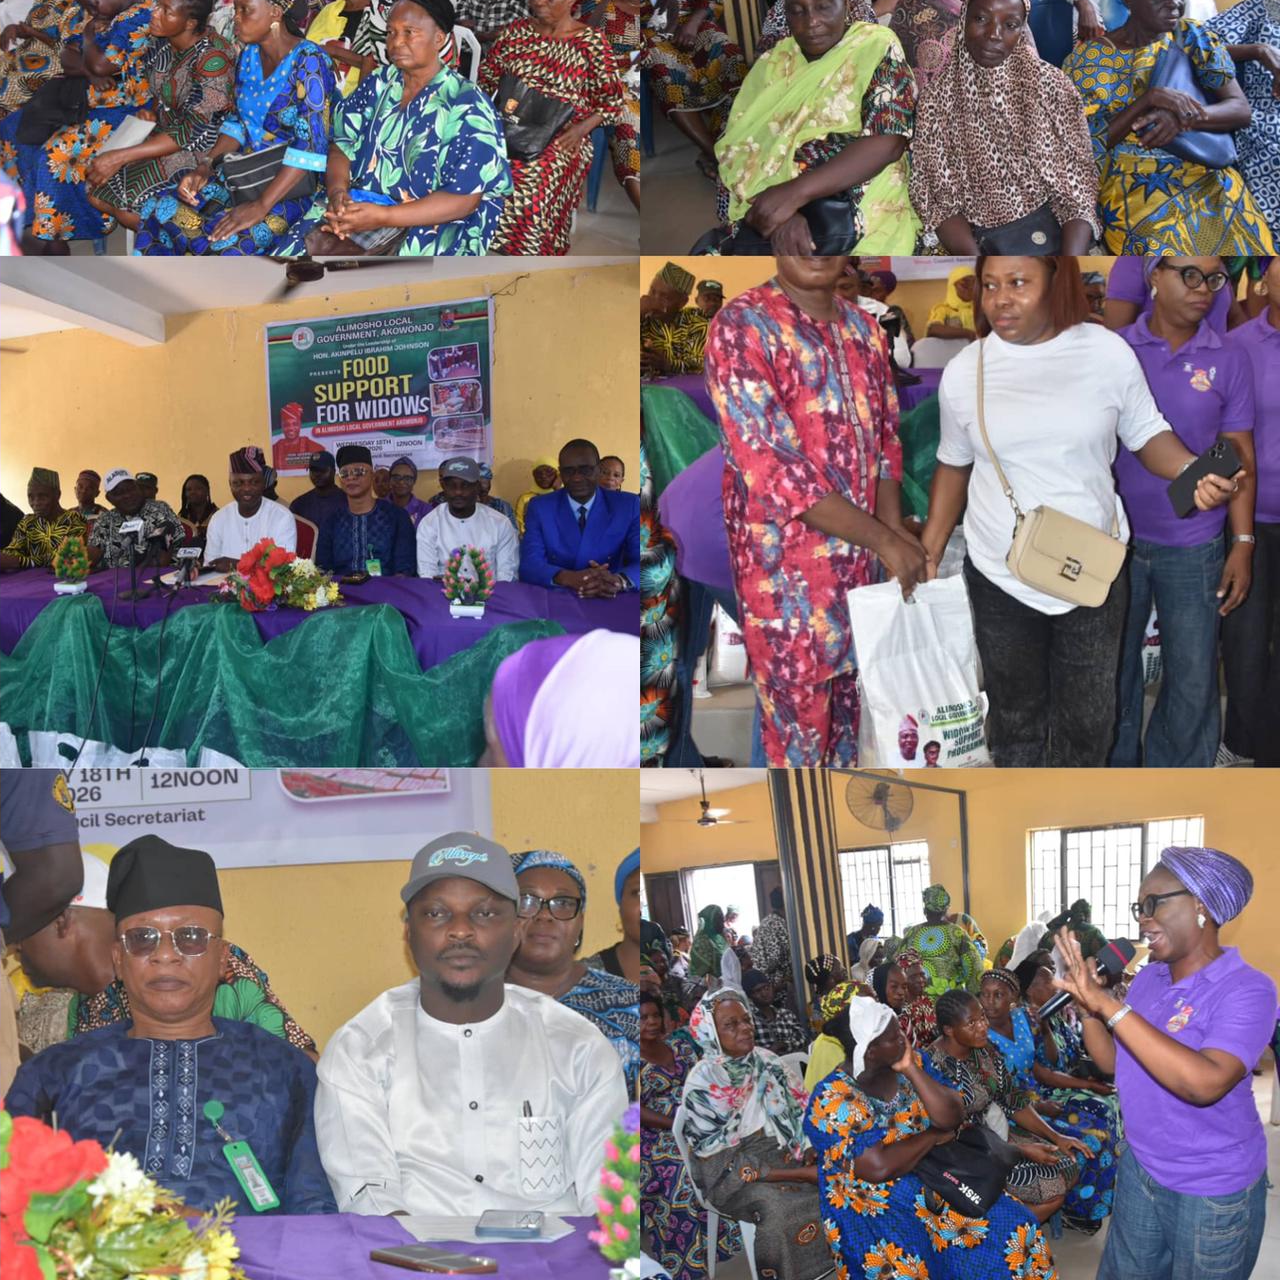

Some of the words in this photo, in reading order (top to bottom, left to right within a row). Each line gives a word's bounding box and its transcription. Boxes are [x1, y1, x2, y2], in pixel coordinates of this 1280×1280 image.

[336, 321, 382, 333] ALIMOSHO
[384, 317, 412, 327] LOCAL
[381, 323, 434, 337] AKOWONJO
[394, 341, 429, 352] JOHNSON
[342, 355, 389, 379] FOOD
[314, 375, 413, 404] SUPPORT
[316, 403, 350, 424] FOR
[80, 768, 131, 783] 18TH
[151, 769, 239, 789] 12NOON
[69, 786, 102, 803] 026
[105, 808, 206, 827] Secretariat
